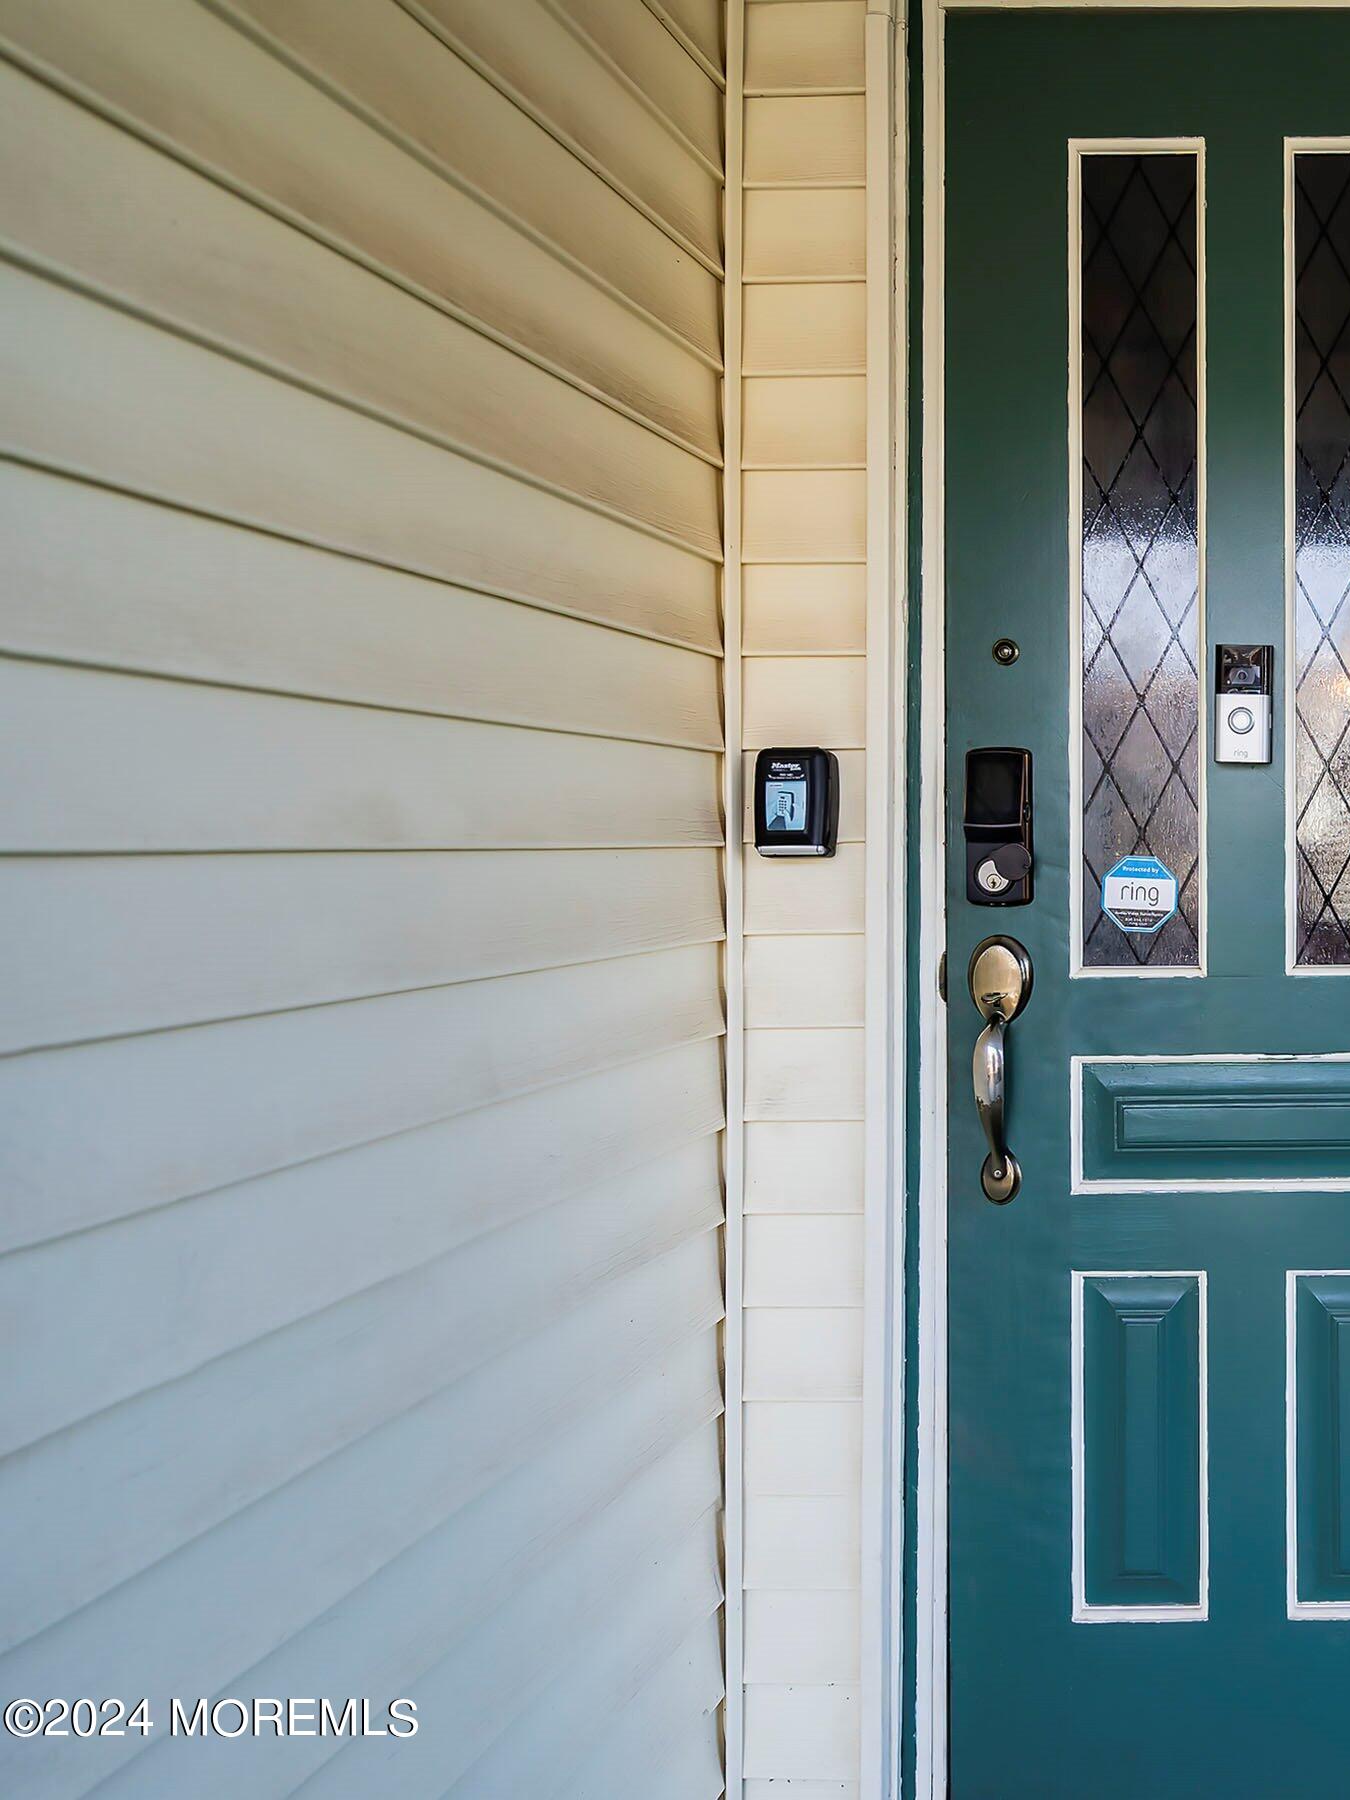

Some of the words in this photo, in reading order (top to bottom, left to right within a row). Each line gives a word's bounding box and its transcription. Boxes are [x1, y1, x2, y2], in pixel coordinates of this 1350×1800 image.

[1233, 749, 1249, 759] ring
[1151, 866, 1159, 874] by
[1120, 881, 1159, 907] ring
